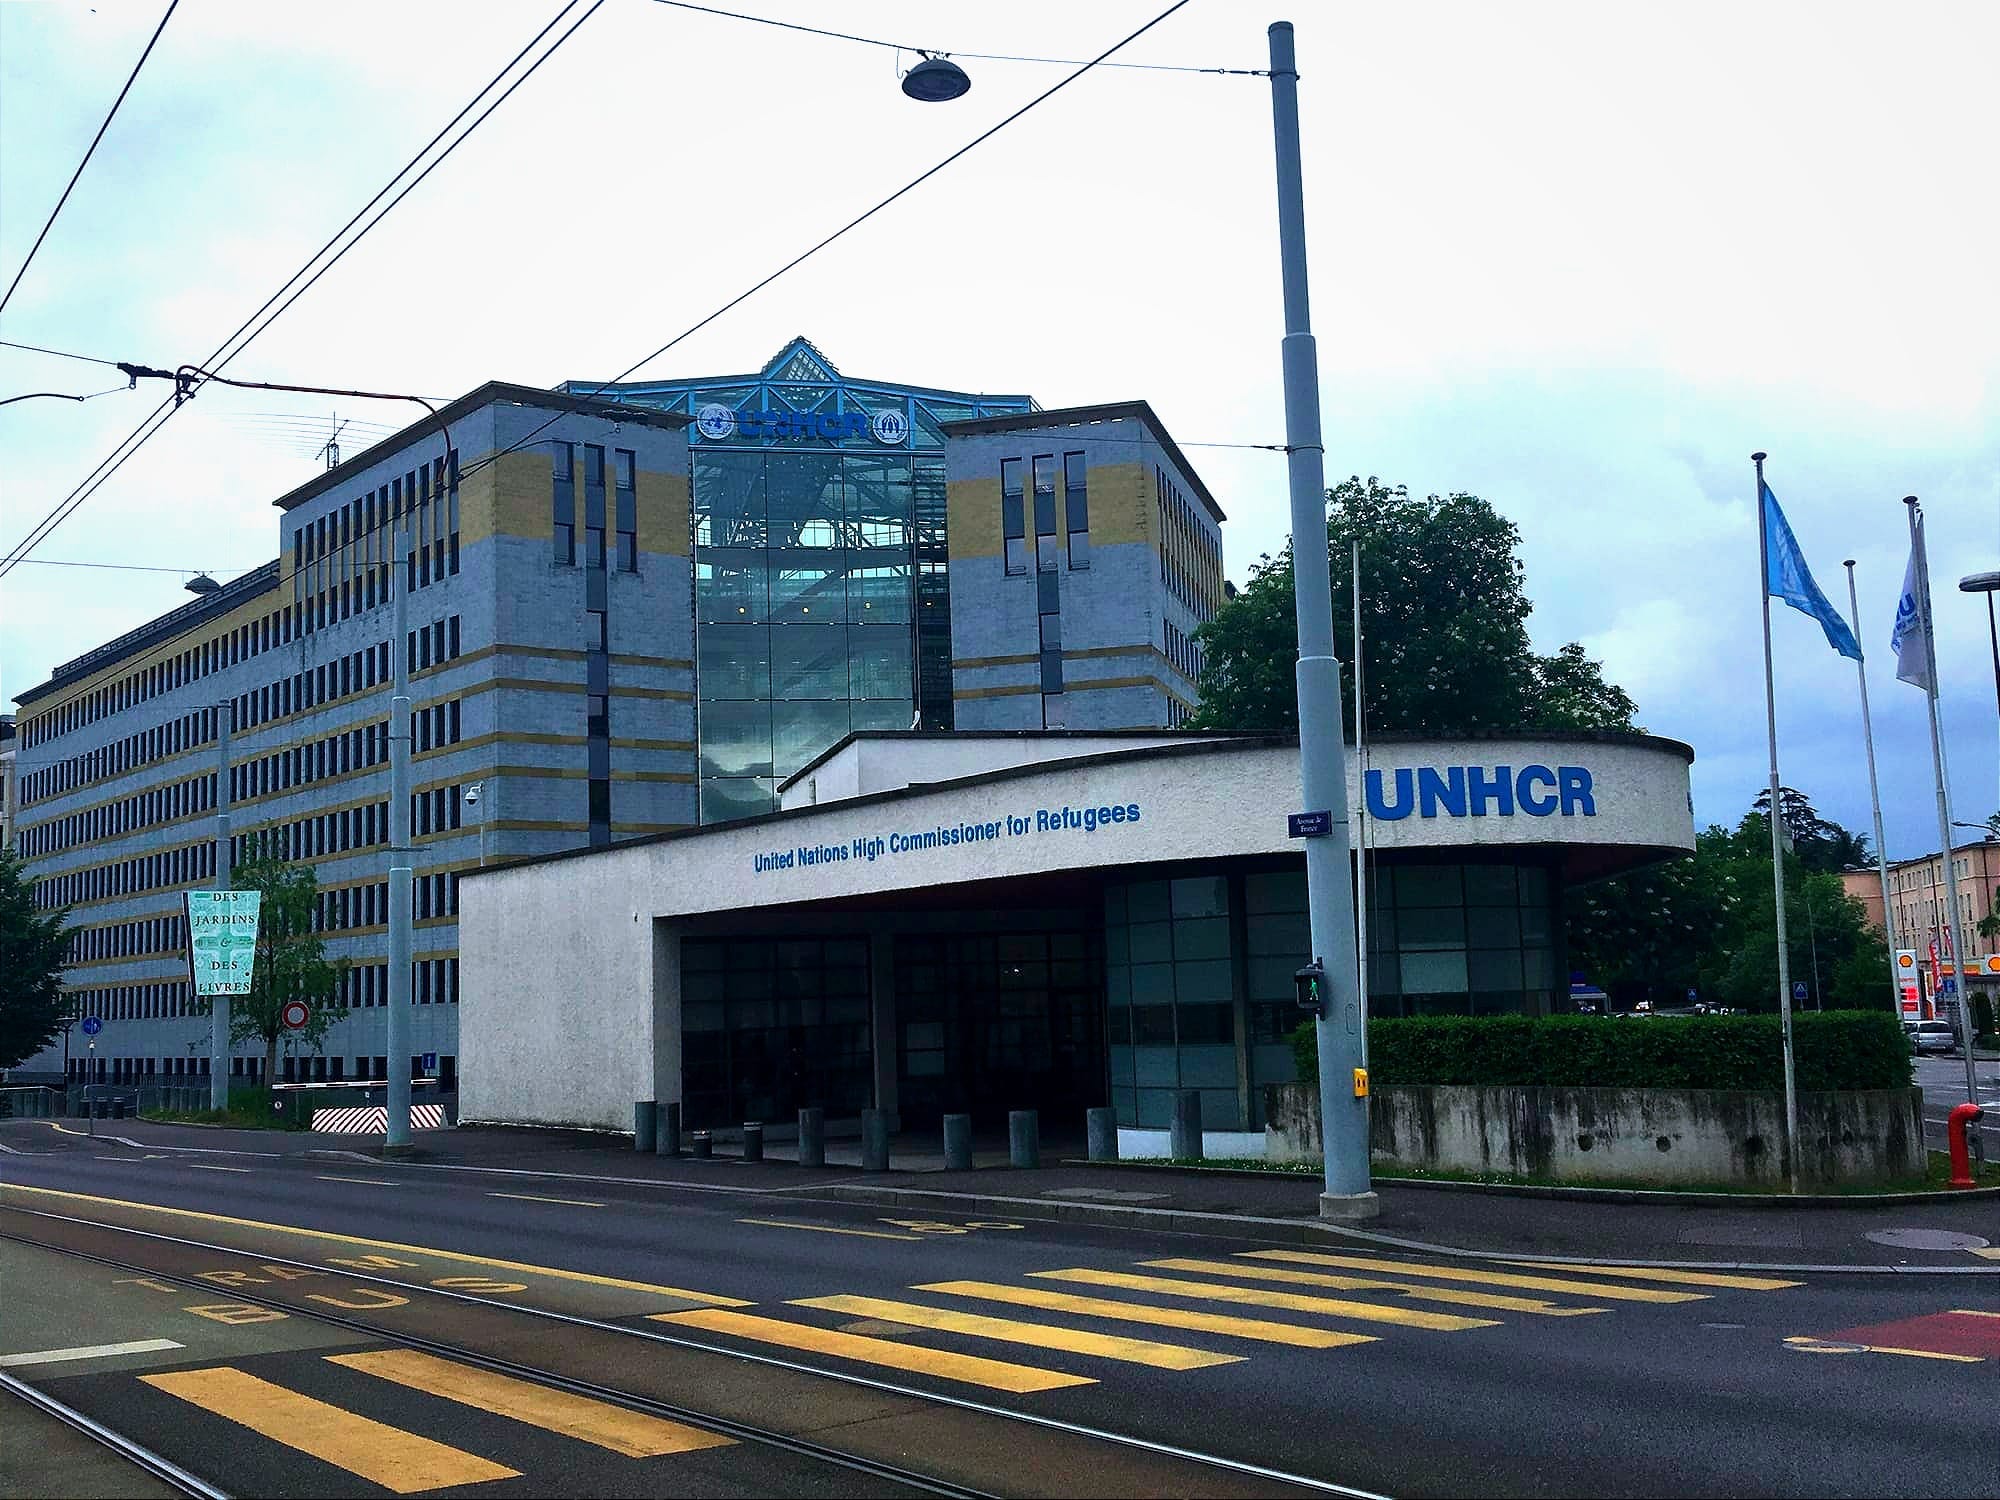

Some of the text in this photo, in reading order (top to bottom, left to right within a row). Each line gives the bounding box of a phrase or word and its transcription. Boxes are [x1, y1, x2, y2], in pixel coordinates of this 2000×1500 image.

[738, 409, 868, 440] UNHCR
[1365, 765, 1597, 821] UNHCR
[755, 803, 1141, 873] United Nations High Commissioner for Refugees
[213, 893, 239, 902] DES
[195, 915, 256, 926] JARDINS
[220, 937, 232, 948] &
[211, 960, 238, 970] DES
[199, 982, 250, 992] LIVRES
[182, 1276, 528, 1326] BUS
